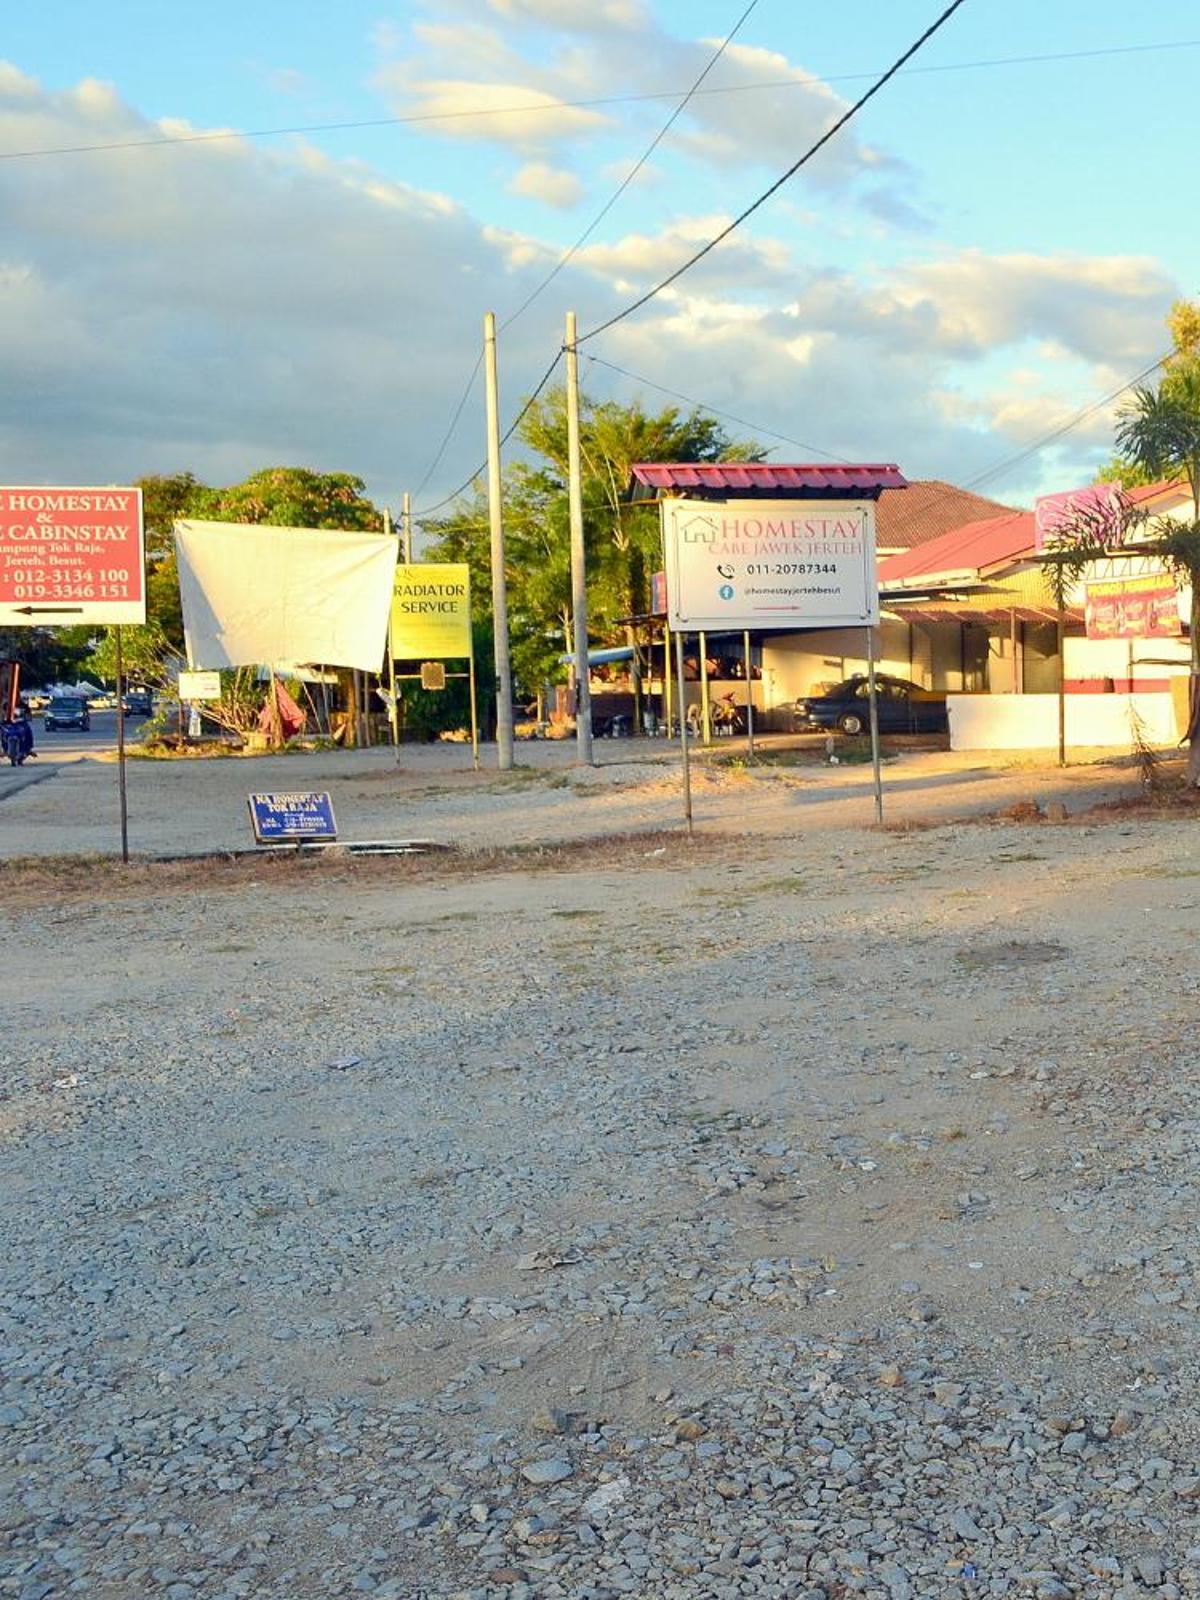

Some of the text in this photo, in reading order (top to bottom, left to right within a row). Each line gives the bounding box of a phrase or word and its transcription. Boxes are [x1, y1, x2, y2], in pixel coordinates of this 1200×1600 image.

[9, 494, 130, 511] HOMESTAY
[35, 512, 54, 524] &
[8, 524, 130, 541] CABINSTAY
[722, 518, 862, 539] HOMESTAY
[14, 569, 94, 583] 012-3134
[99, 569, 129, 583] 100
[746, 564, 837, 575] 011-20787344
[14, 584, 129, 598] 019-3346 151
[394, 584, 465, 597] RADIATOR
[401, 600, 459, 614] SERVICE
